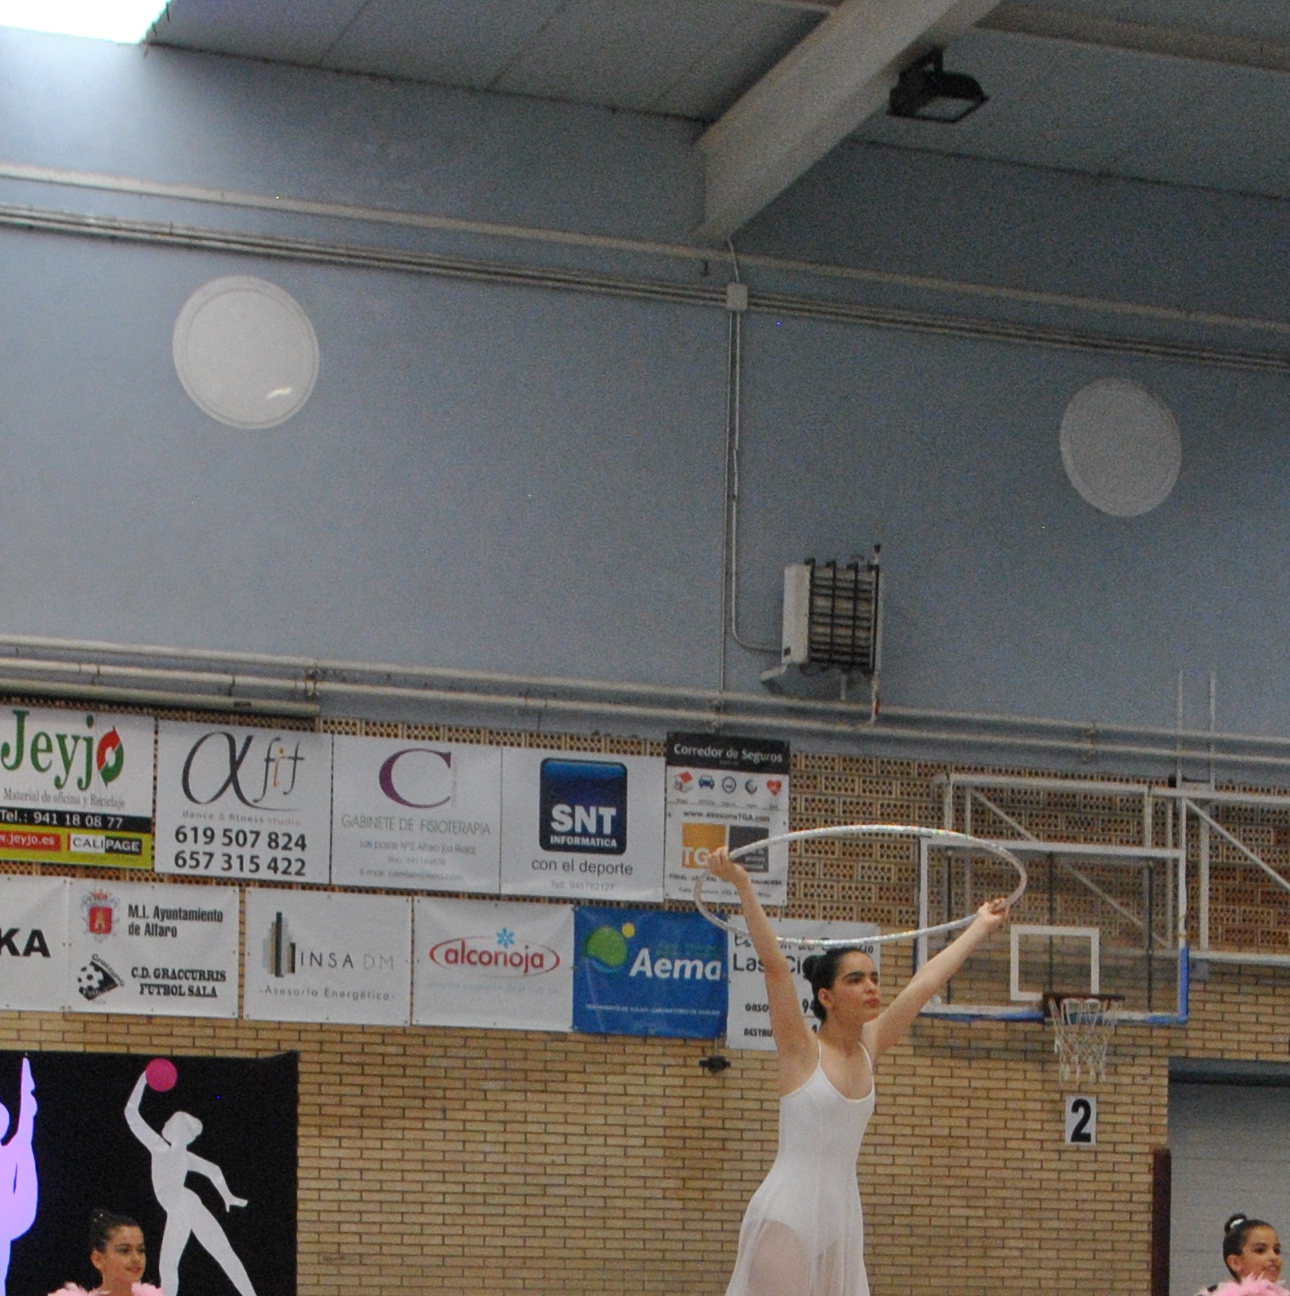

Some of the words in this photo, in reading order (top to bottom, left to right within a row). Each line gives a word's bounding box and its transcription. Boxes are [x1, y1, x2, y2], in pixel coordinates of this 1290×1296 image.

[674, 743, 722, 758] Corredor
[726, 748, 738, 759] de
[742, 749, 783, 763] Seguros
[34, 812, 58, 825] 941
[65, 814, 80, 826] 18
[86, 815, 102, 827] 08
[107, 817, 123, 829] 77
[342, 814, 395, 830] GABINETE
[399, 818, 414, 831] DE
[420, 819, 491, 835] FISIOTERAPIA
[551, 804, 616, 835] SNT
[175, 825, 215, 845] 619
[221, 828, 261, 849] 507
[267, 832, 307, 852] 824
[550, 835, 617, 847] INFORMATICA
[174, 850, 215, 870] 657
[221, 853, 260, 873] 315
[267, 856, 306, 876] 422
[531, 859, 557, 870] con
[562, 859, 574, 872] el
[579, 859, 633, 876] deporte
[153, 906, 223, 922] Ayuntamiento
[128, 923, 140, 936] de
[144, 923, 177, 938] Alfaro
[301, 952, 354, 969] INSA
[628, 947, 722, 981] Aema
[733, 953, 765, 972] Las
[131, 967, 150, 980] C.D.
[154, 967, 226, 982] GRACCURRIS
[140, 983, 186, 997] FUTBOL
[188, 985, 217, 998] SALA
[1070, 1098, 1092, 1143] 2
